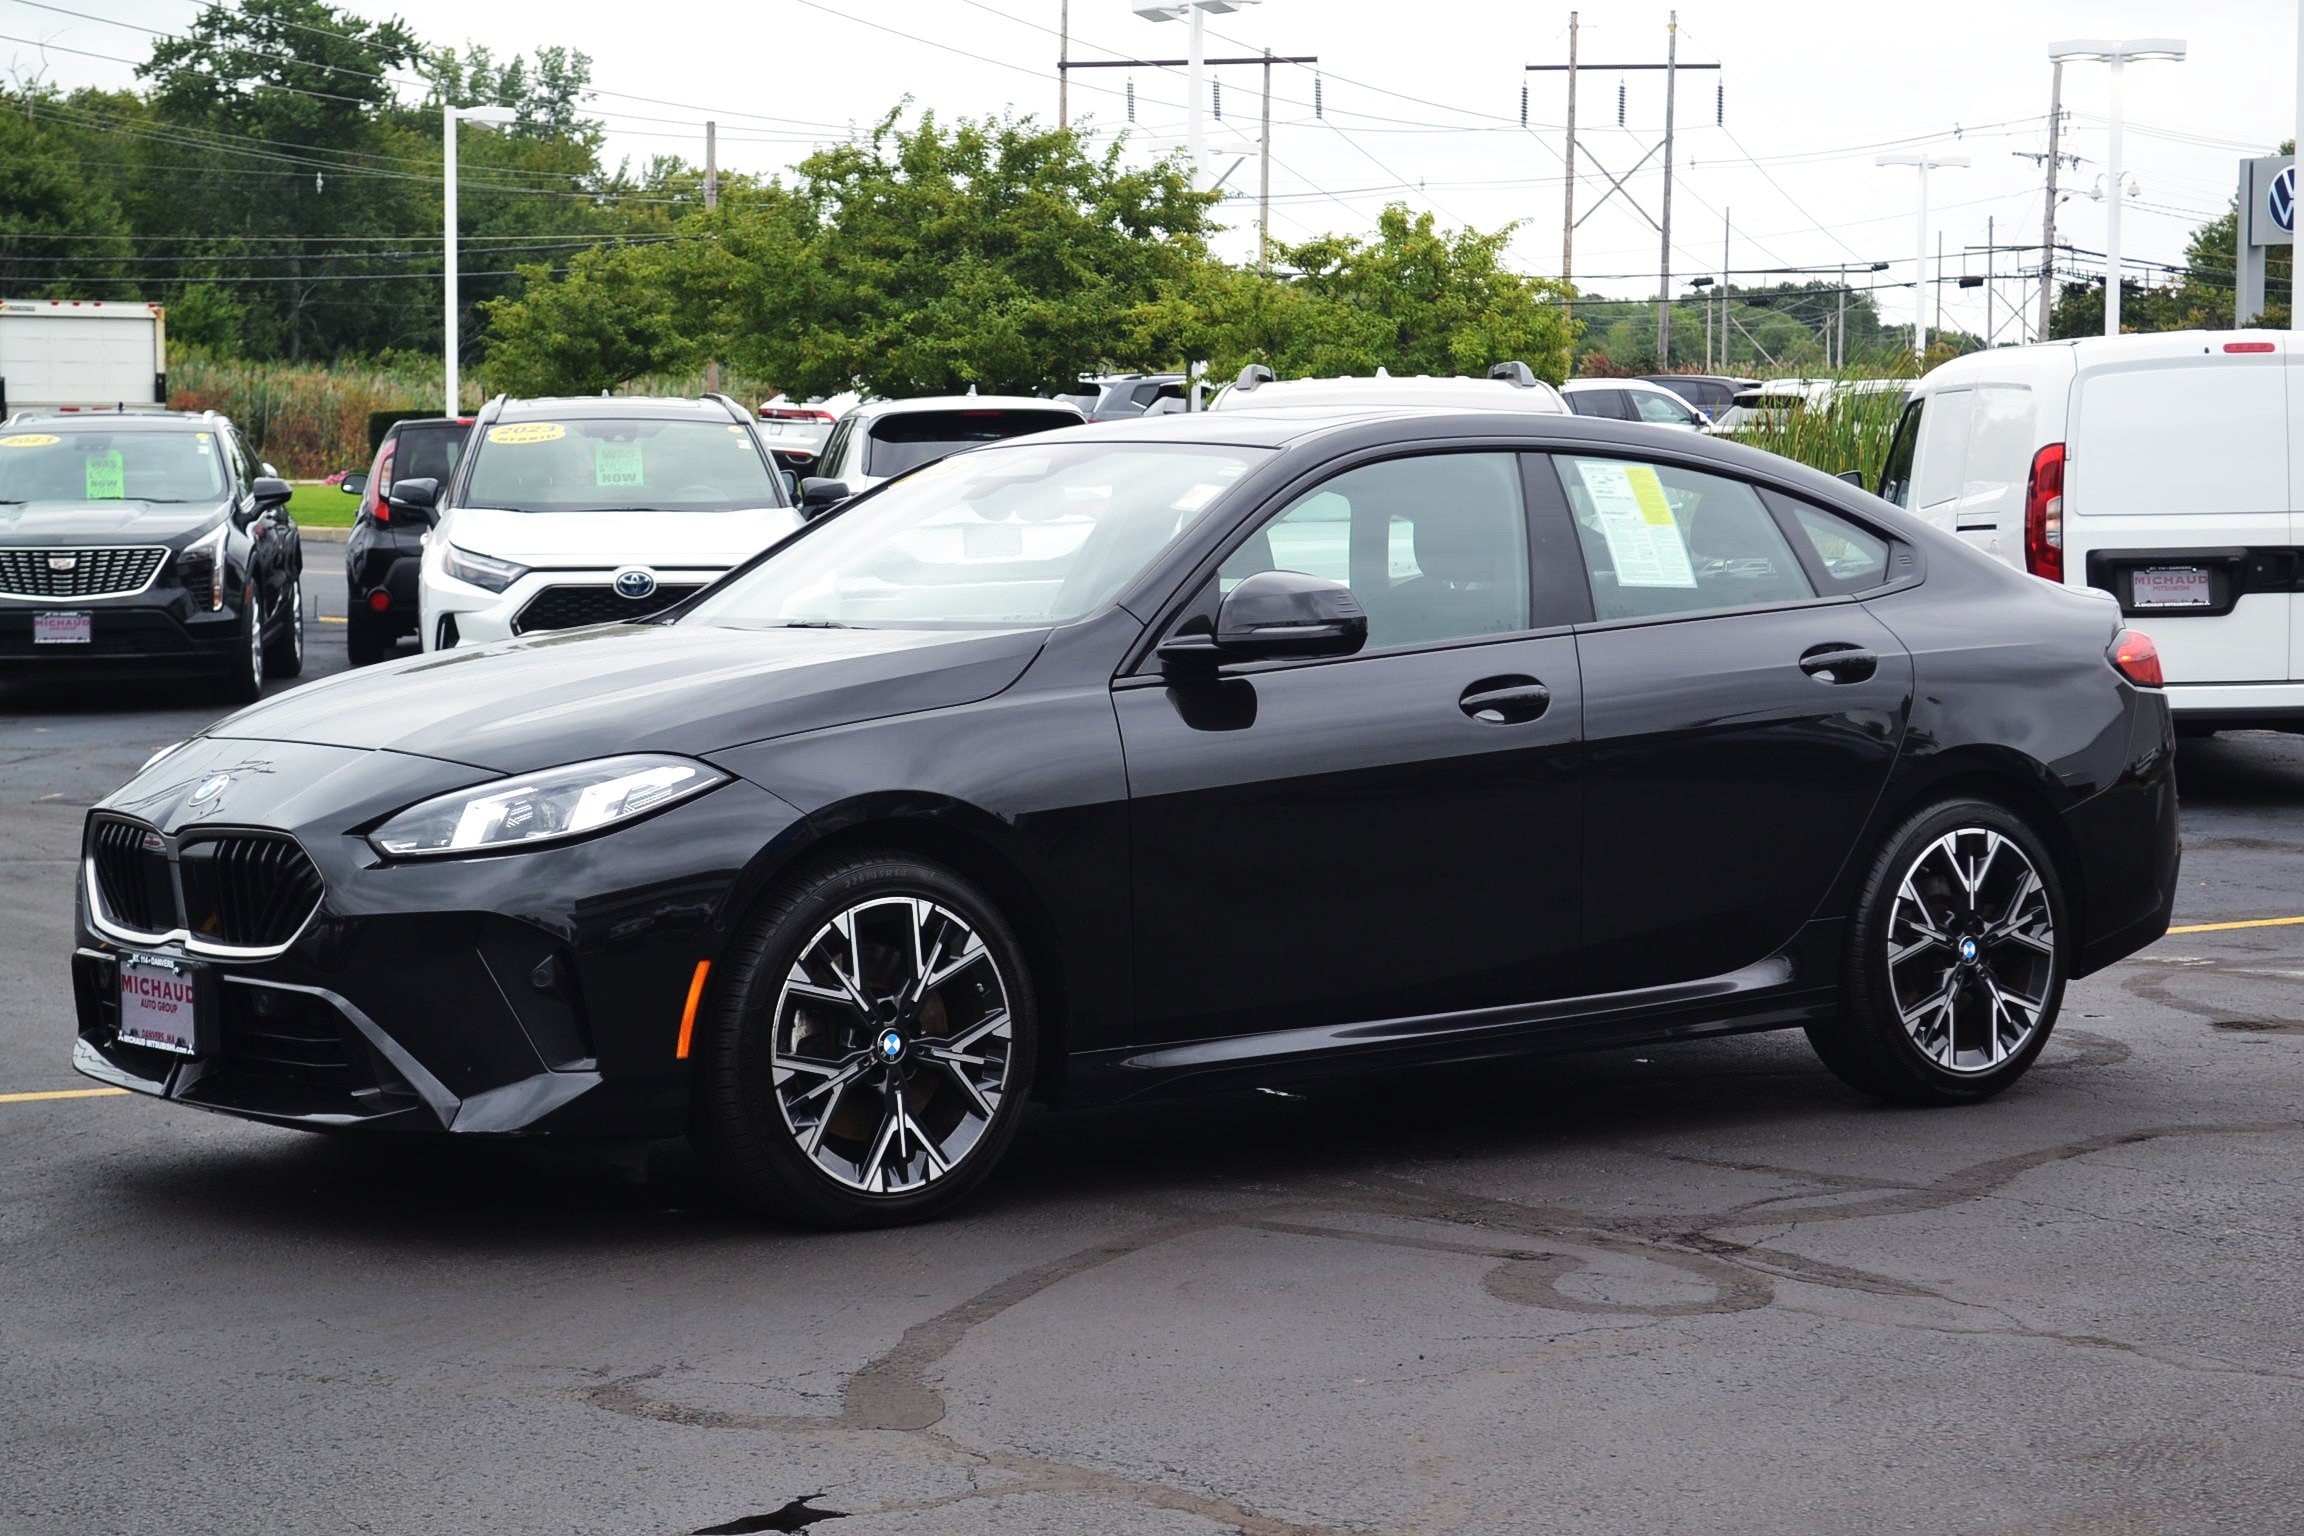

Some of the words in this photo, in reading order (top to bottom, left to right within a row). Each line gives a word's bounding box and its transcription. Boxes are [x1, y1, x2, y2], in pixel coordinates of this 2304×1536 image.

[602, 473, 636, 483] NOW
[90, 480, 118, 488] NOW
[2135, 576, 2208, 585] MICHAUD
[121, 974, 193, 1004] MICHAUD
[141, 999, 156, 1010] AUTO
[158, 1001, 178, 1014] GROUP
